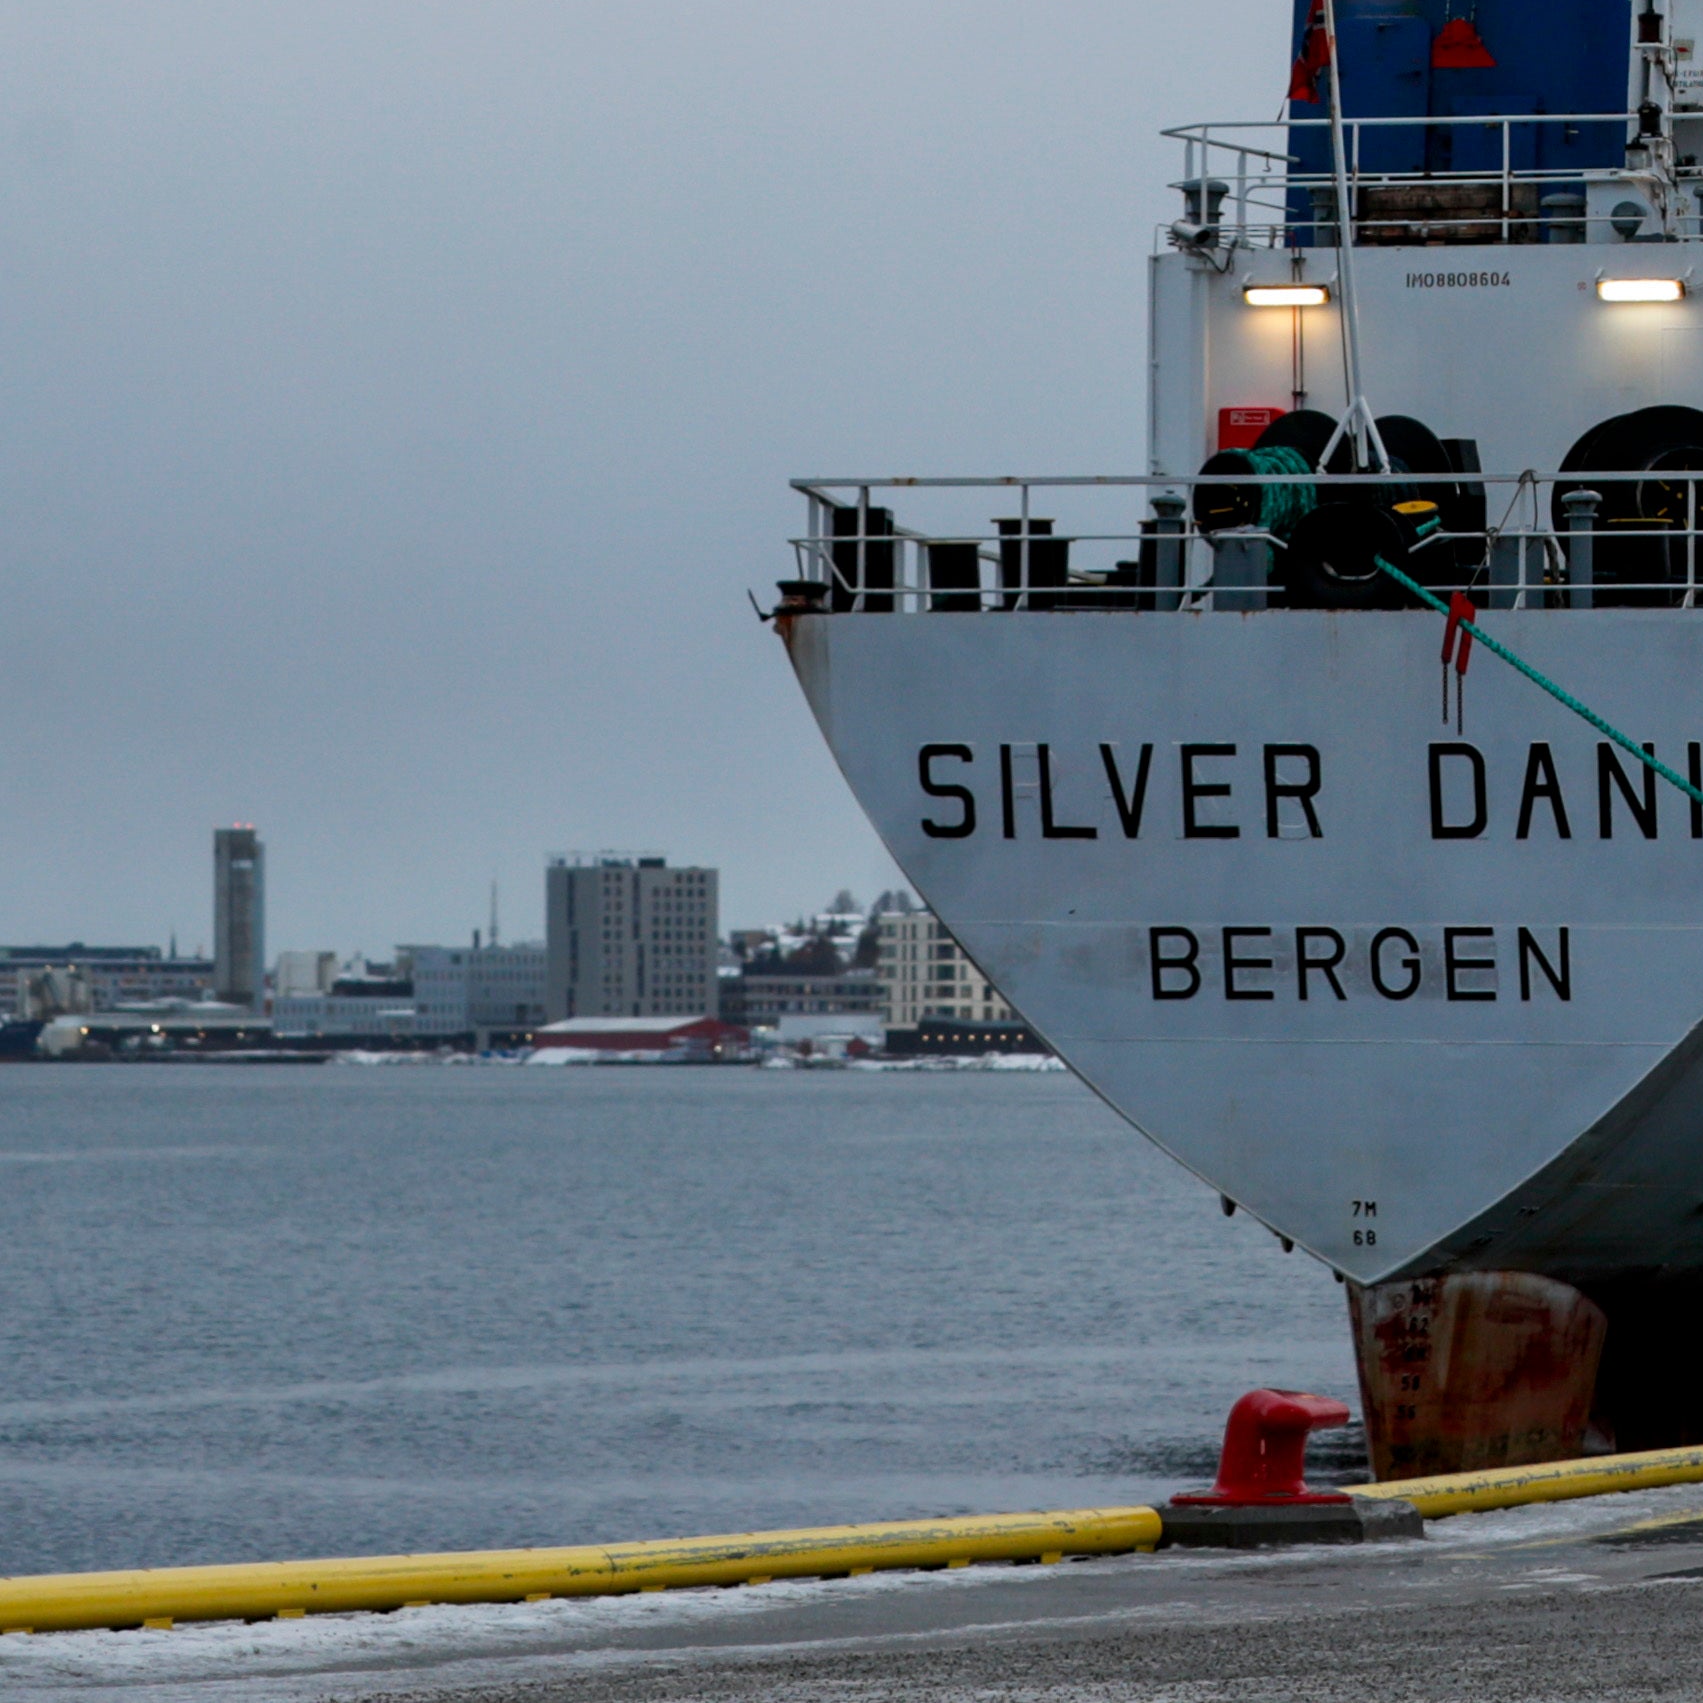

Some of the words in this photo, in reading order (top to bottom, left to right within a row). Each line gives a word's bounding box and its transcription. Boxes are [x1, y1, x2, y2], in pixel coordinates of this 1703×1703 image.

[918, 742, 1324, 840] SILVER
[1148, 925, 1572, 1002] BERGEN
[1352, 1201, 1378, 1217] 7M
[1353, 1230, 1377, 1246] 68
